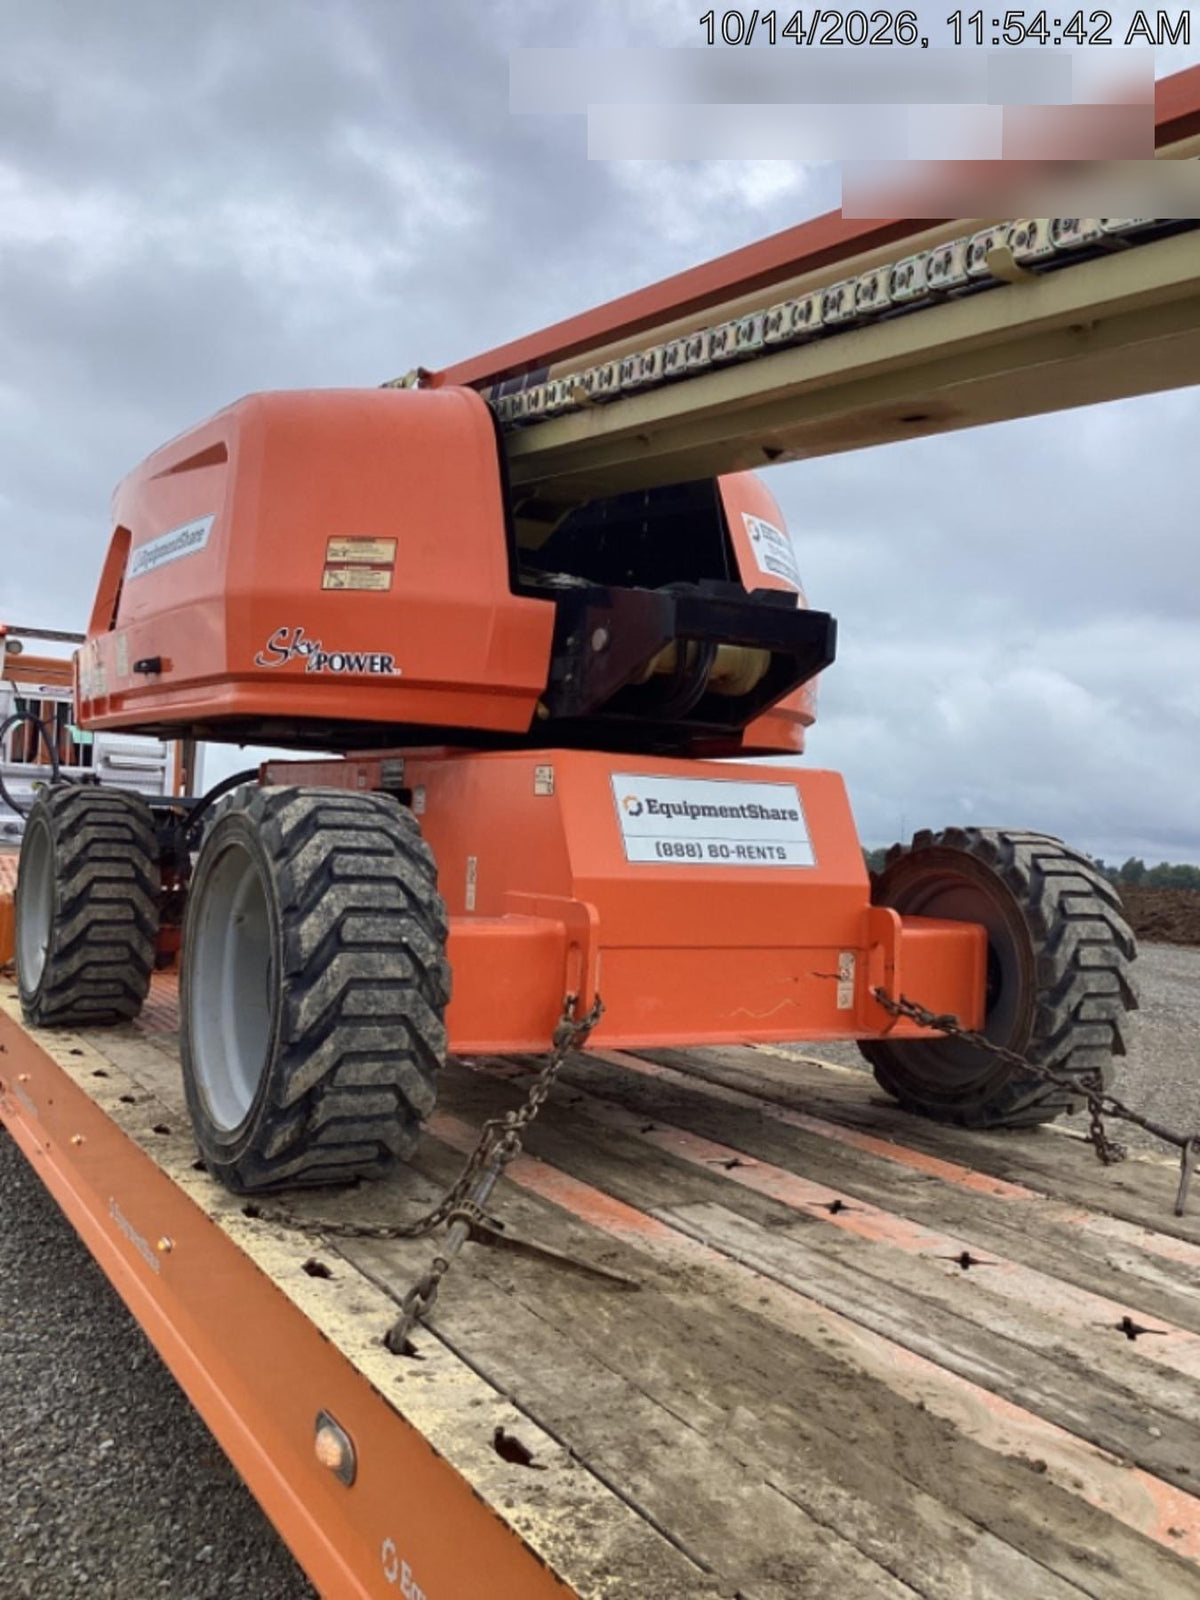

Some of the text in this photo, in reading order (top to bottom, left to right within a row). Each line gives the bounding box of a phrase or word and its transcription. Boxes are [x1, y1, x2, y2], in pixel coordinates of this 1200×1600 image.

[254, 626, 396, 675] Sky POWER
[646, 797, 799, 822] EquipmentShare
[656, 841, 787, 860] (888) 80-RENTS
